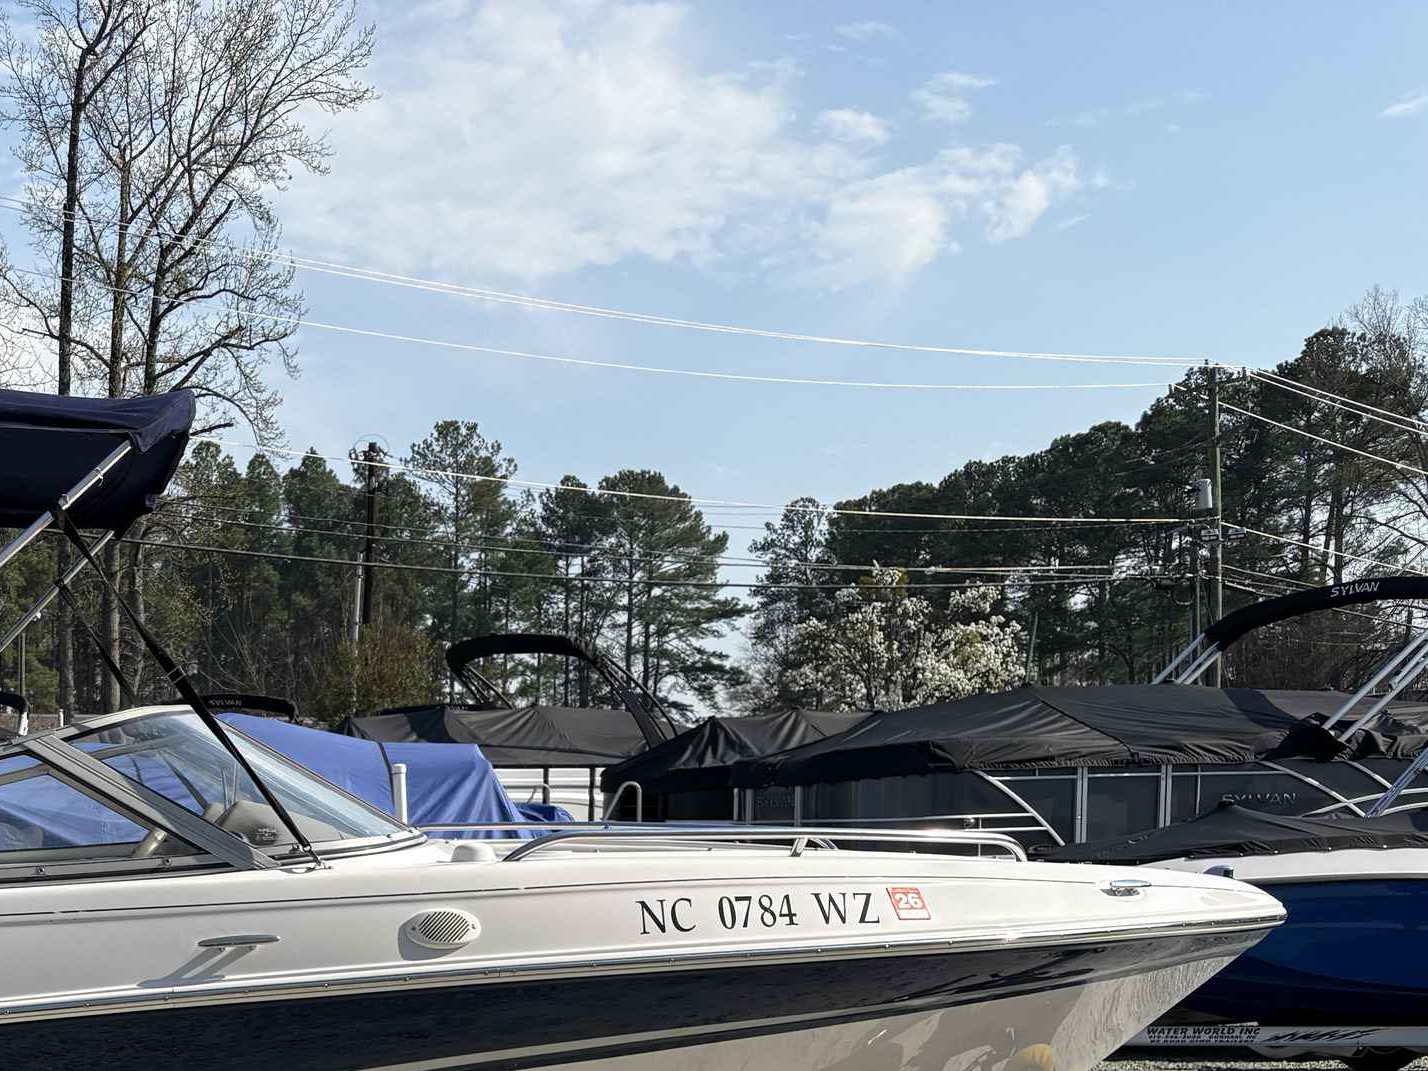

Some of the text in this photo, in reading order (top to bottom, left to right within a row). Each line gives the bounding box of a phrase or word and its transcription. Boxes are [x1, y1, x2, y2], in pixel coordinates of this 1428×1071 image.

[1330, 582, 1380, 598] SYLVAN
[893, 892, 924, 909] 26
[635, 892, 880, 935] NC 0784 WZ
[1147, 1027, 1188, 1035] WATER
[1193, 1027, 1235, 1035] WORLD
[1240, 1027, 1260, 1035] INC
